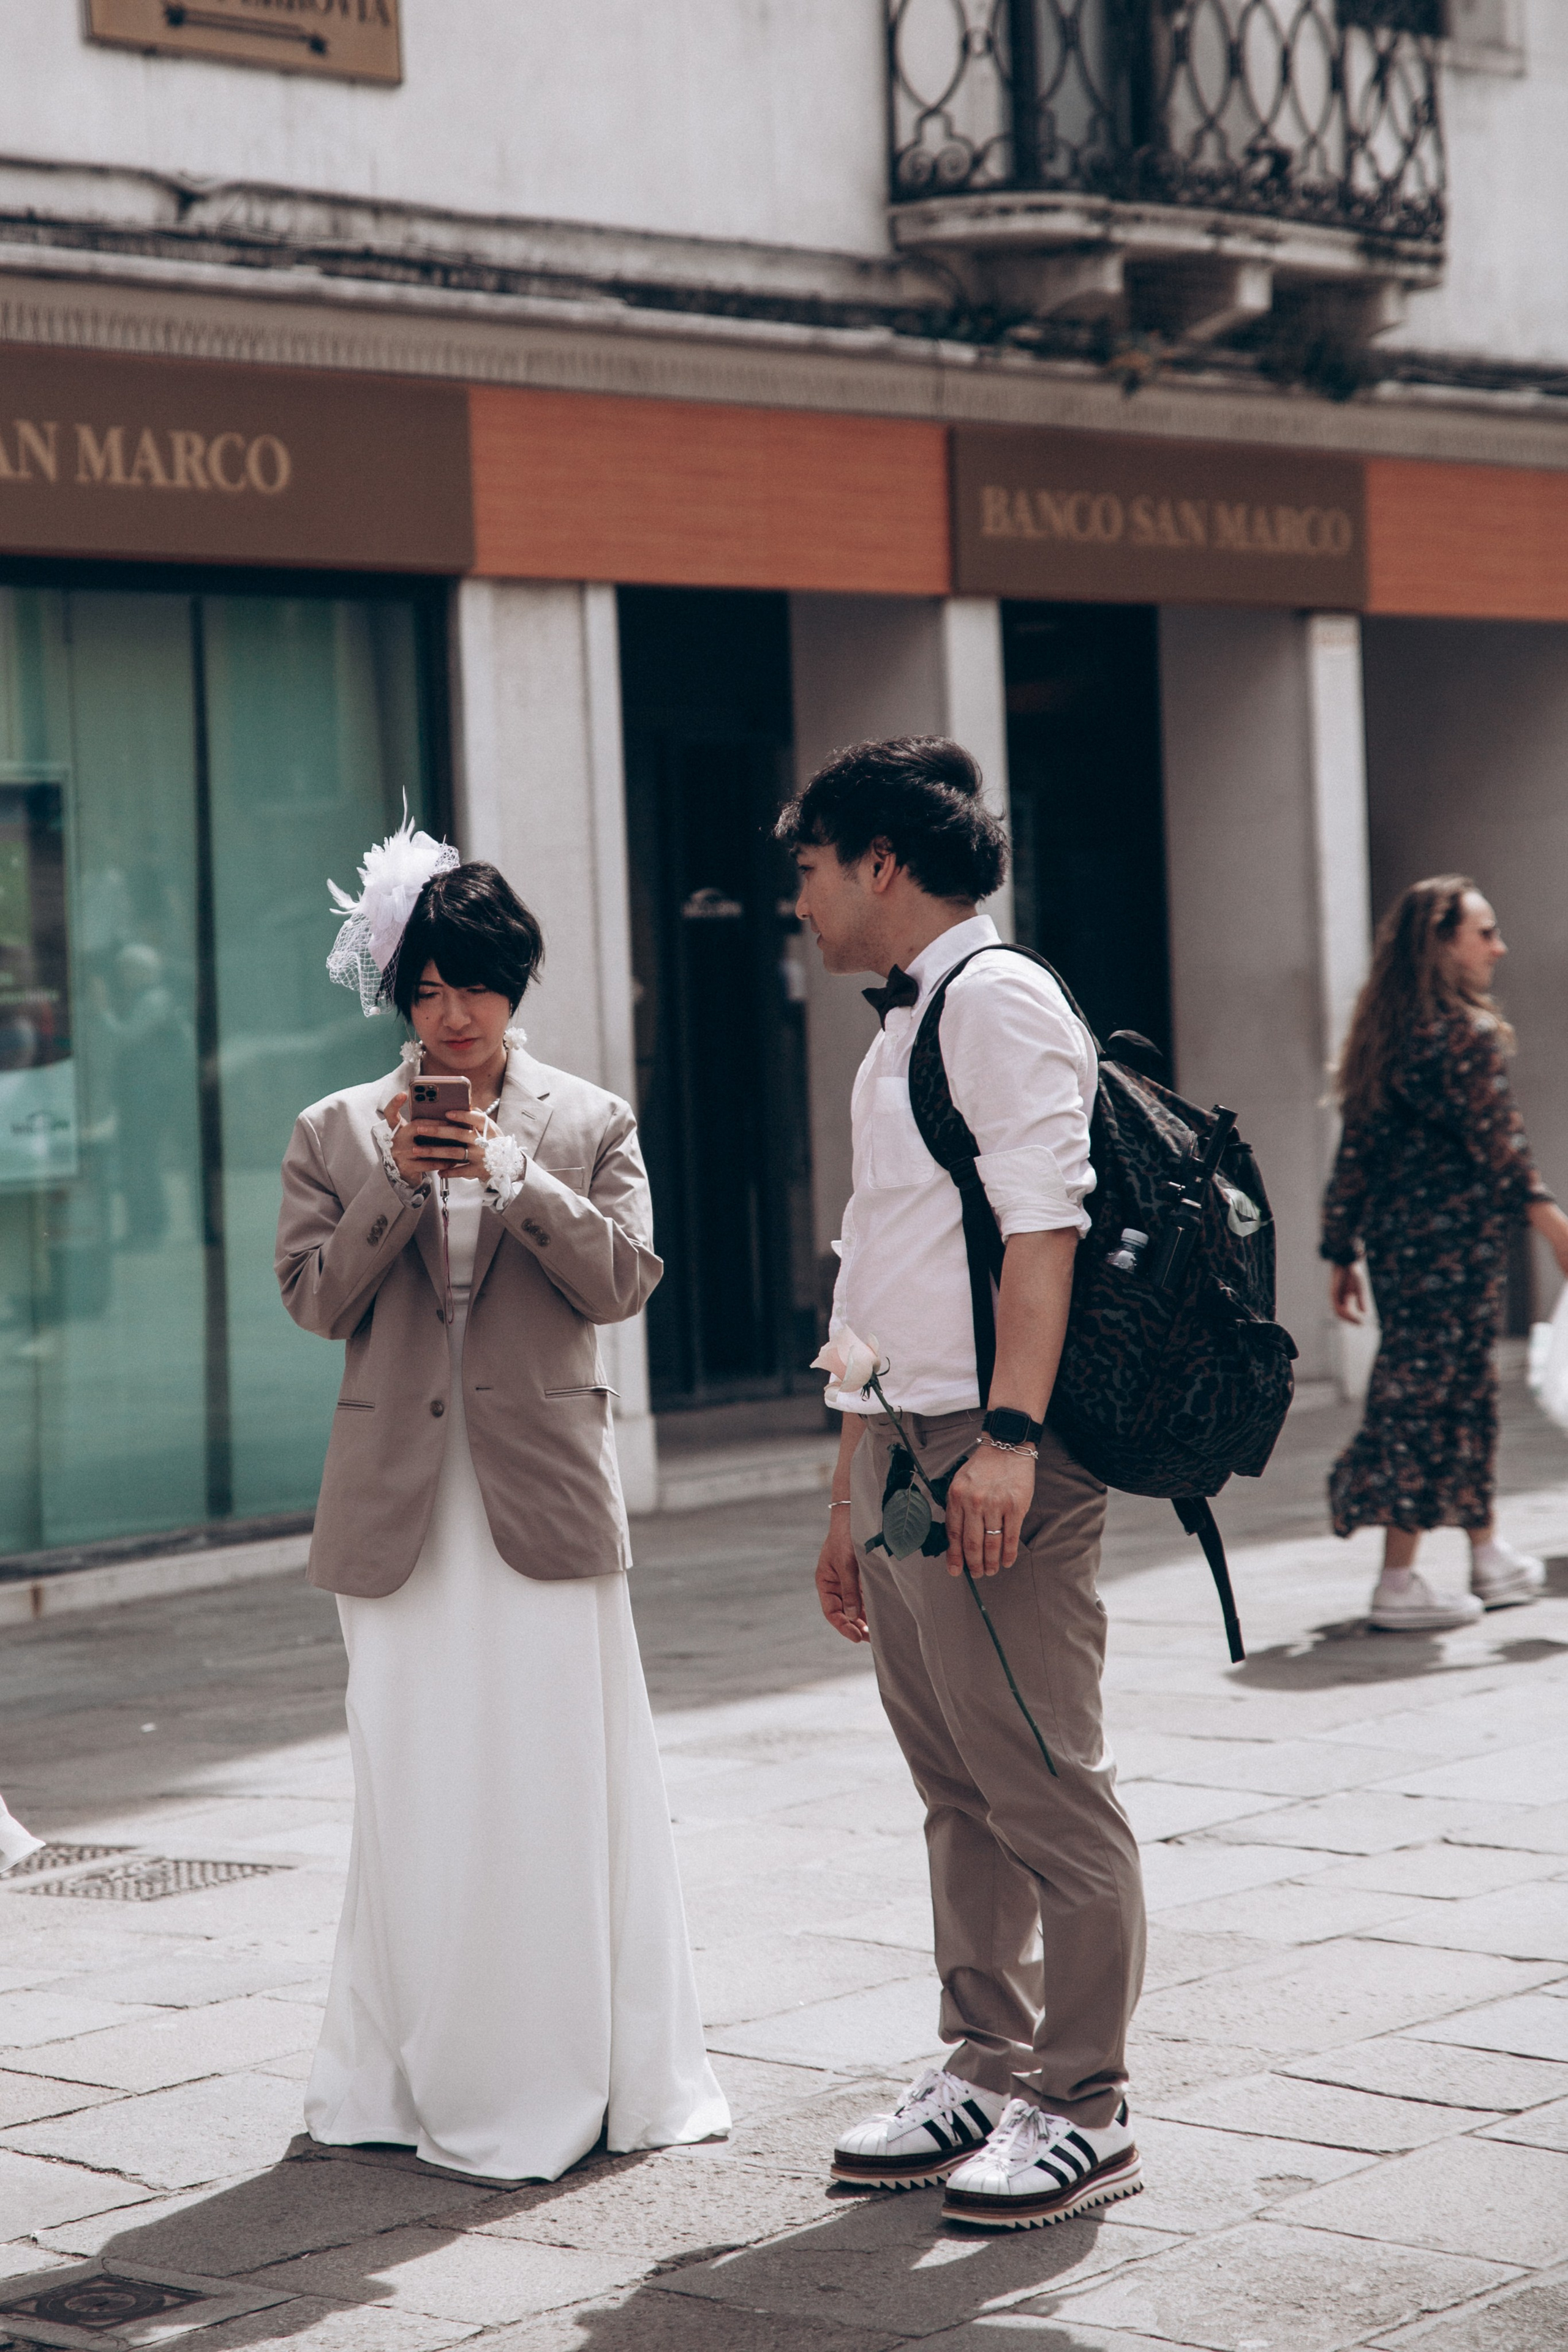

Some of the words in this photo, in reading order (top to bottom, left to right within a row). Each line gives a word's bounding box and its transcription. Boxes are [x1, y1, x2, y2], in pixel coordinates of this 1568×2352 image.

[74, 423, 292, 495] MARCO
[981, 486, 1124, 544] BANCO
[1129, 494, 1208, 548] SAN
[1213, 500, 1353, 556] MARCO
